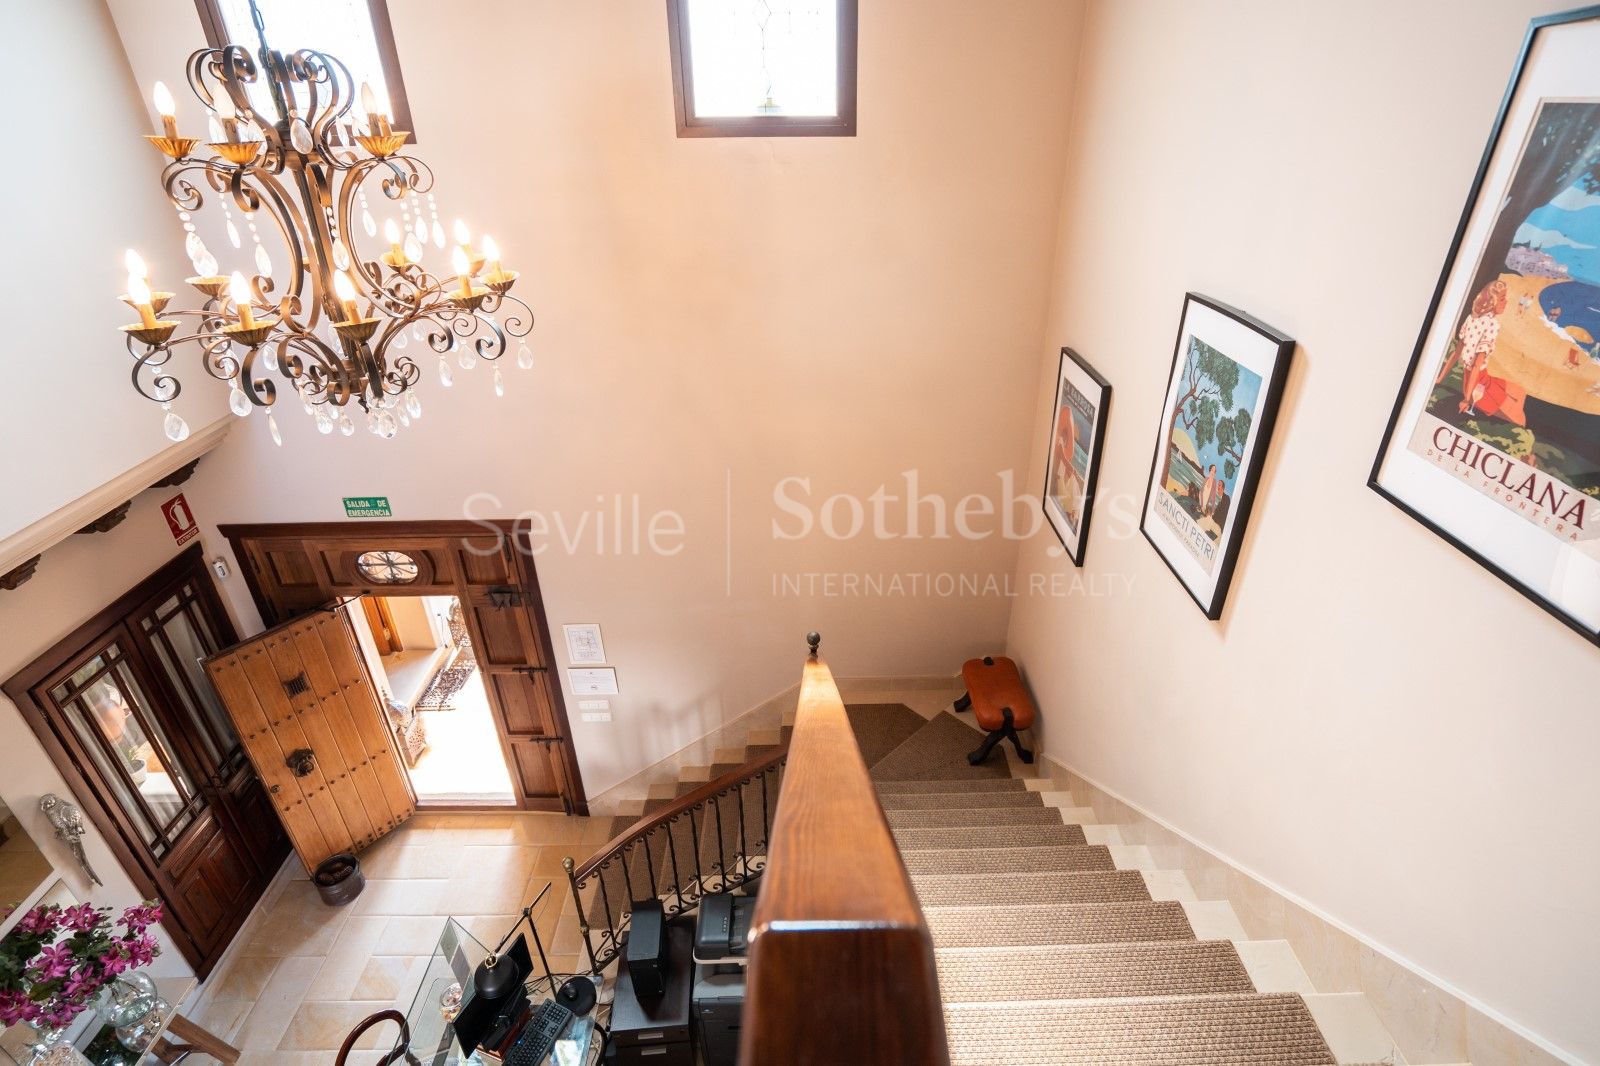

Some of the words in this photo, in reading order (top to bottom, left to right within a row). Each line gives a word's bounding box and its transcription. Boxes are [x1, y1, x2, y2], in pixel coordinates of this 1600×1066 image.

[1427, 449, 1442, 462] DE
[1455, 465, 1470, 478] LA
[1482, 481, 1578, 541] FRONTERA
[1433, 426, 1585, 530] CHICLANA
[346, 500, 370, 508] SALIDA
[348, 509, 390, 517] EMERGENCIA
[1190, 526, 1214, 560] PETRI
